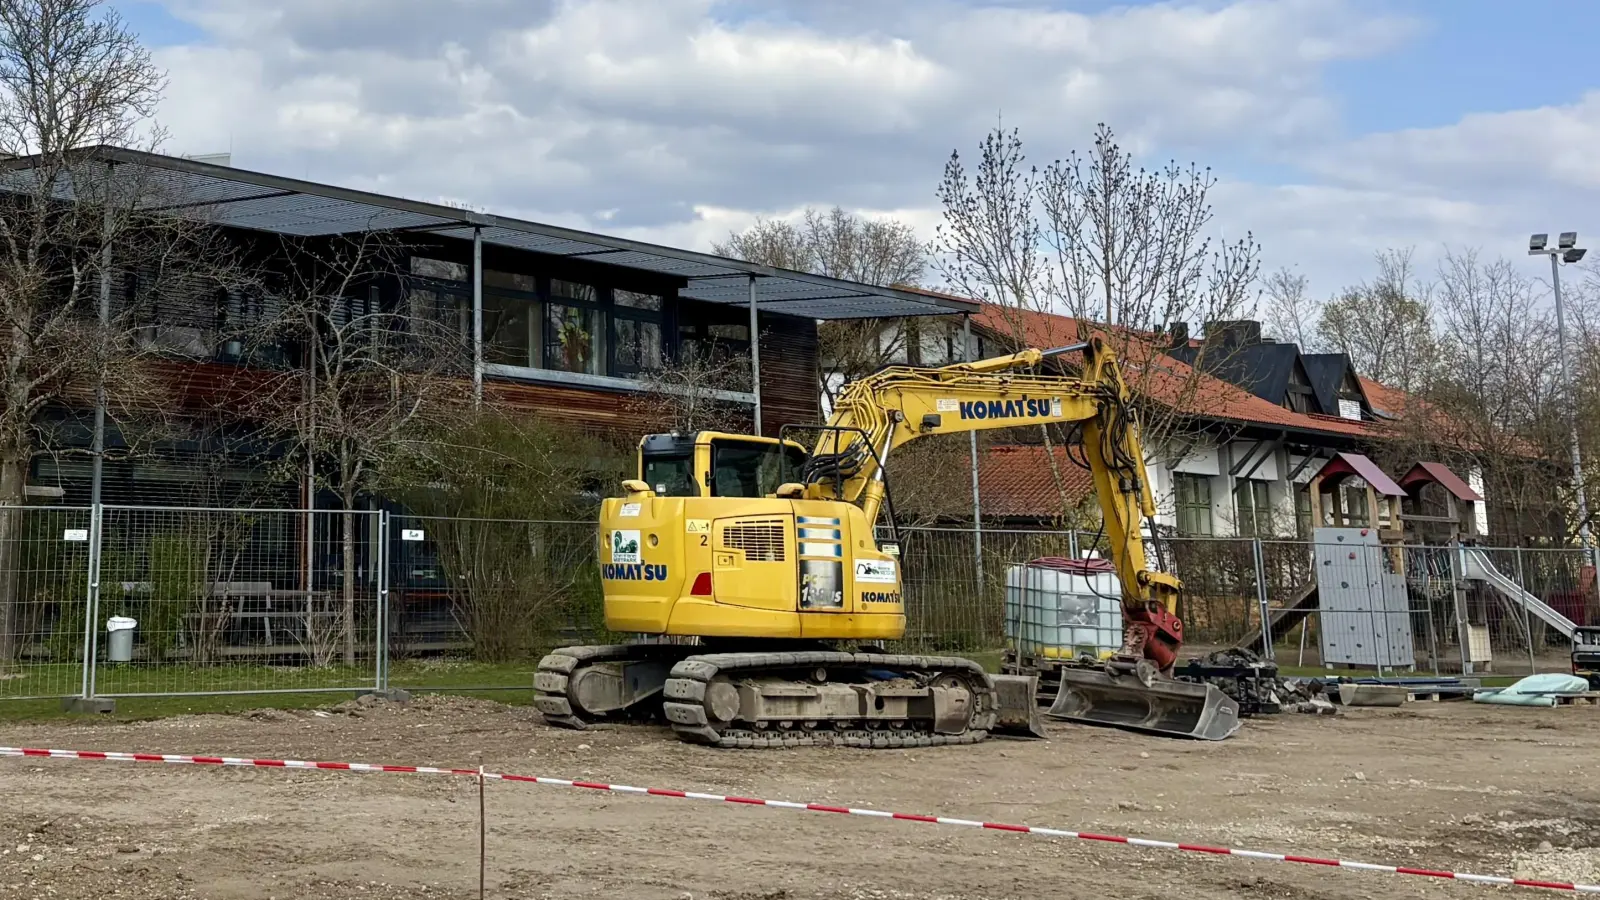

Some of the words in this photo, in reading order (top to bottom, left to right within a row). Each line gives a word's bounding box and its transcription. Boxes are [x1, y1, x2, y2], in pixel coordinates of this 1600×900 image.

[959, 394, 1050, 420] KOMATSU
[700, 534, 708, 546] 2
[601, 560, 667, 581] KOMATSU
[861, 590, 901, 603] KOMATS
